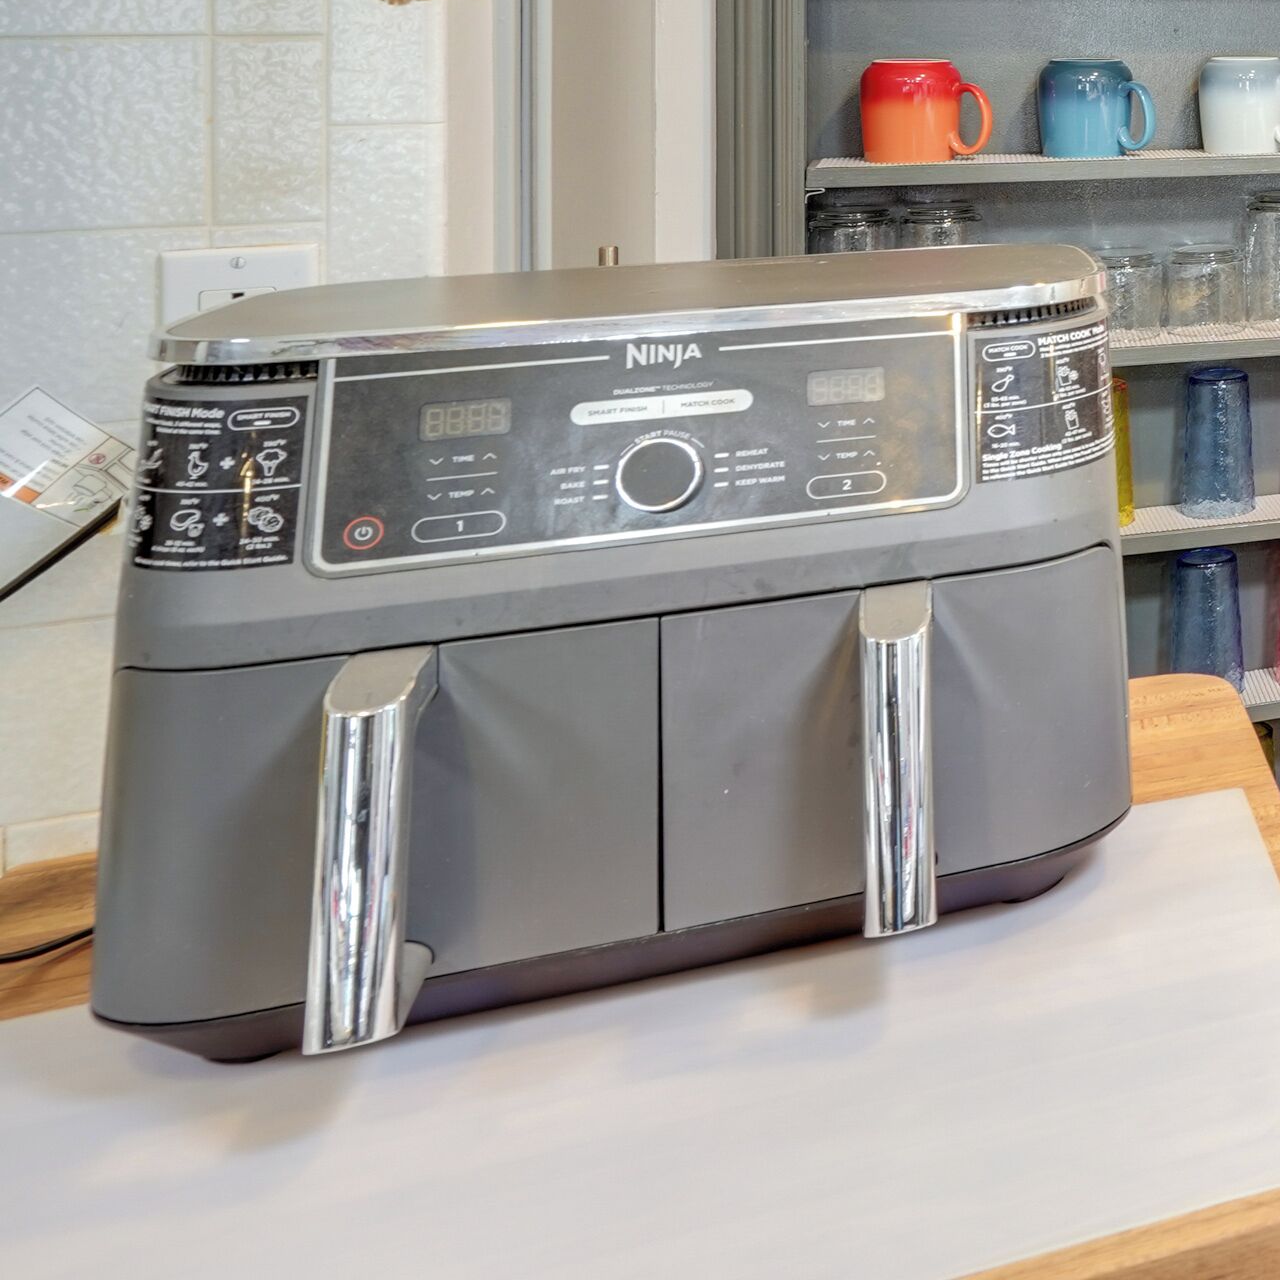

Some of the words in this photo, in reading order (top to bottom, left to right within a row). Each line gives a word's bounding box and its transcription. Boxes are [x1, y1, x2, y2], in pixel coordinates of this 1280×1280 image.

[1037, 334, 1069, 346] MATCH
[626, 343, 702, 369] NINJA
[662, 381, 714, 392] TECHNOLOGY
[680, 400, 709, 408] MATCH
[711, 398, 736, 406] COOK
[588, 408, 618, 417] SMART
[619, 406, 648, 414] FINISH
[634, 429, 662, 445] START
[663, 429, 691, 440] PAUSE
[982, 452, 1009, 462] Single
[1009, 448, 1030, 458] Zone
[1031, 443, 1062, 454] Cooking
[736, 461, 785, 472] DEHYDRATE
[842, 479, 852, 490] 2
[456, 520, 464, 532] 1
